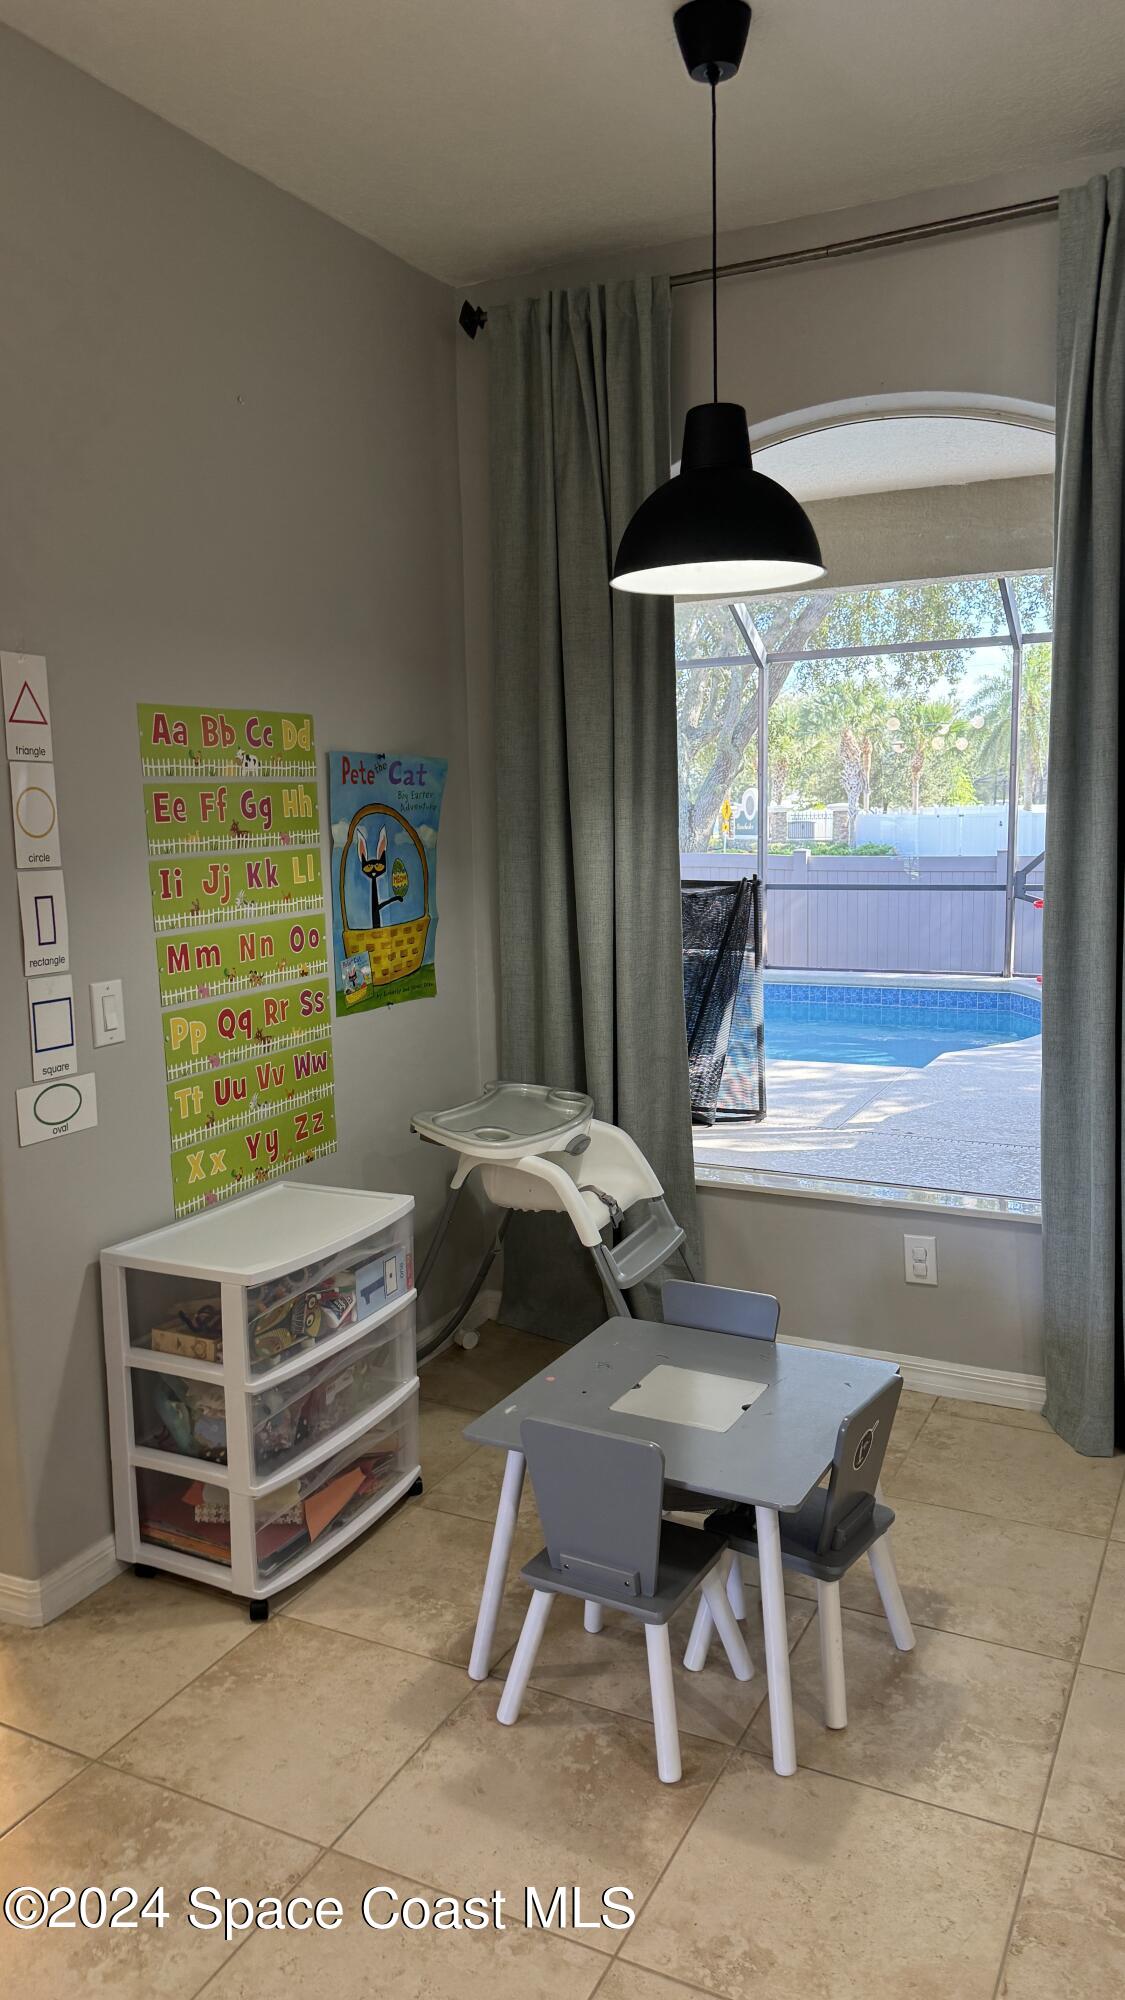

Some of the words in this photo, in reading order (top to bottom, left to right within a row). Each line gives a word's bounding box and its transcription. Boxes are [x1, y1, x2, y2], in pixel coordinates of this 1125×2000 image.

[151, 712, 188, 747] Aa
[200, 714, 236, 748] Bb
[245, 717, 274, 748] Cc
[281, 719, 311, 751] Dd
[15, 745, 46, 758] triangle
[342, 756, 375, 785] Pete
[374, 761, 387, 774] the
[388, 761, 427, 786] Cat
[152, 791, 188, 824] Ee
[199, 785, 228, 823] Ff
[240, 789, 273, 831] Gg
[281, 785, 313, 818] Hh
[28, 852, 51, 864] circle
[159, 868, 183, 900] Ii
[201, 863, 231, 905] Jj
[245, 857, 280, 889] Kk
[292, 854, 315, 884] Ll
[29, 954, 66, 969] rectangle
[166, 942, 222, 975] Mm
[238, 932, 274, 963] Nn
[289, 924, 320, 953] Oo
[169, 1016, 207, 1055] Pp
[217, 1007, 253, 1040] Qq
[264, 997, 289, 1027] Rr
[299, 989, 325, 1017] Ss
[42, 1063, 70, 1076] square
[174, 1085, 203, 1119] Tt
[214, 1076, 247, 1107] Uu
[255, 1061, 285, 1091] Vv
[293, 1050, 328, 1080] Ww
[52, 1123, 69, 1135] oval
[186, 1149, 227, 1184] Xx
[245, 1129, 279, 1164] Yy
[293, 1110, 324, 1142] Zz
